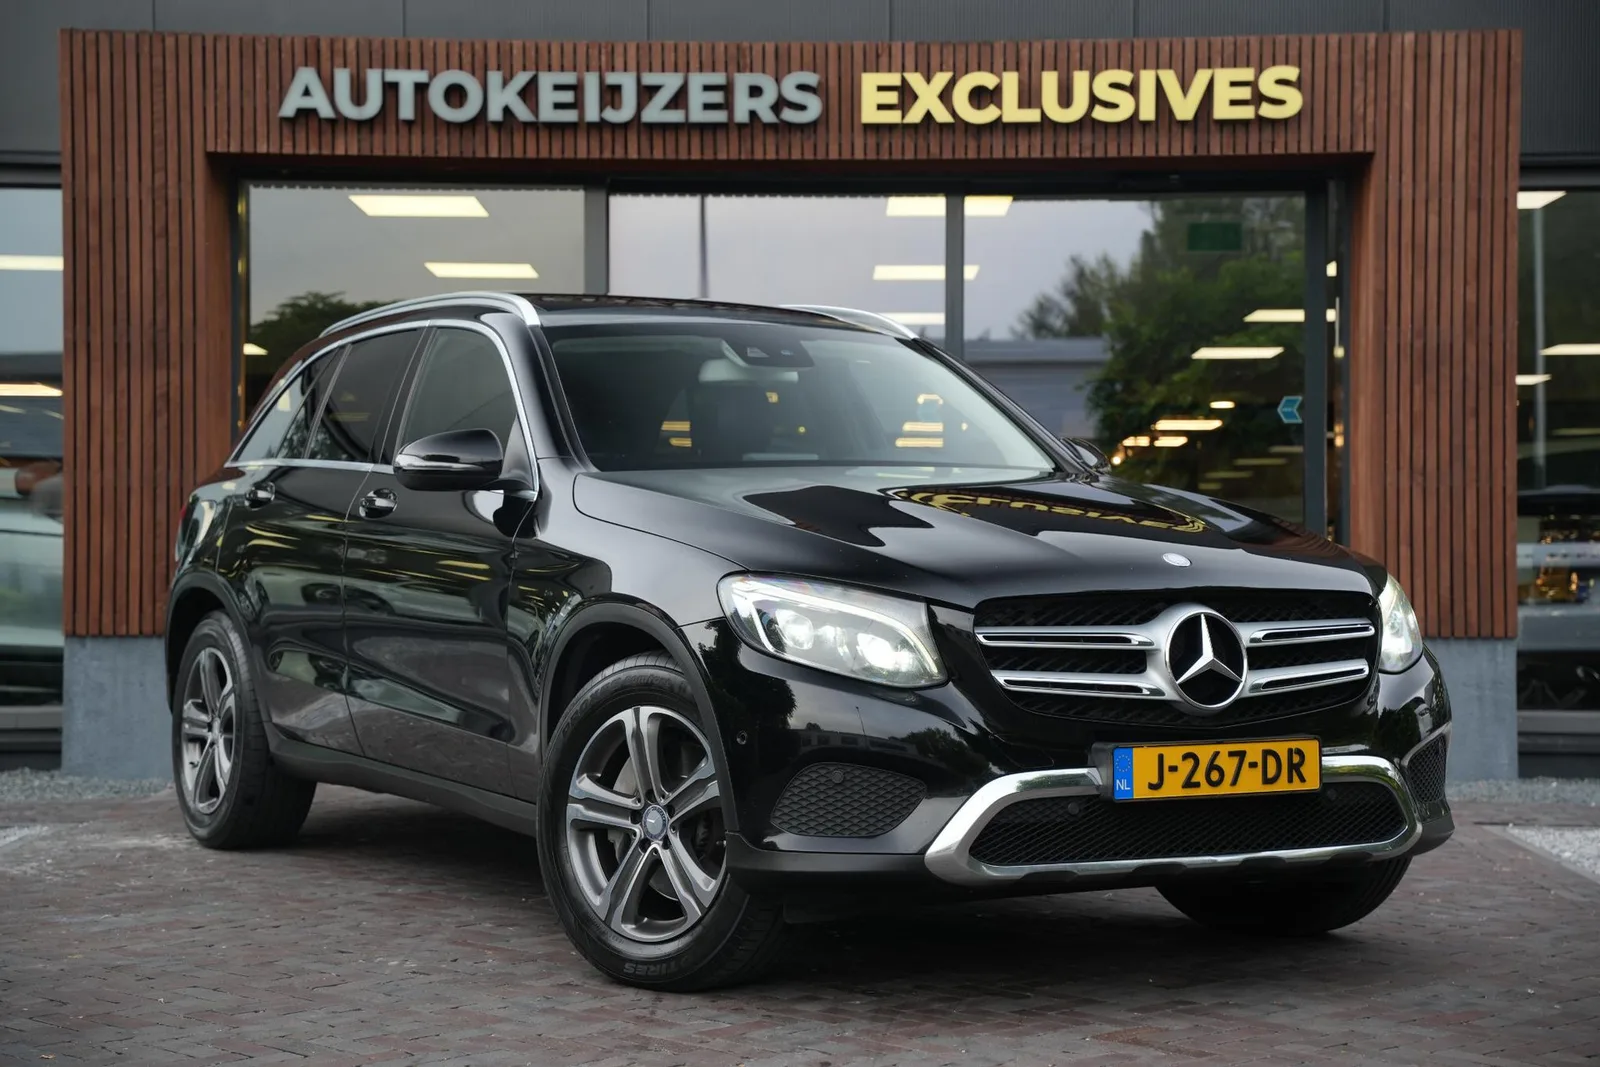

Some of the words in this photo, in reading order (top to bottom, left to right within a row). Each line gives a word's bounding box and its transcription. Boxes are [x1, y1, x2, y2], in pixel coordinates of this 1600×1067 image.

[278, 66, 823, 125] AUTOKEIJZERS
[860, 65, 1304, 125] EXCLUSIVES
[1116, 779, 1131, 791] NL
[1147, 747, 1307, 791] J-267-DR
